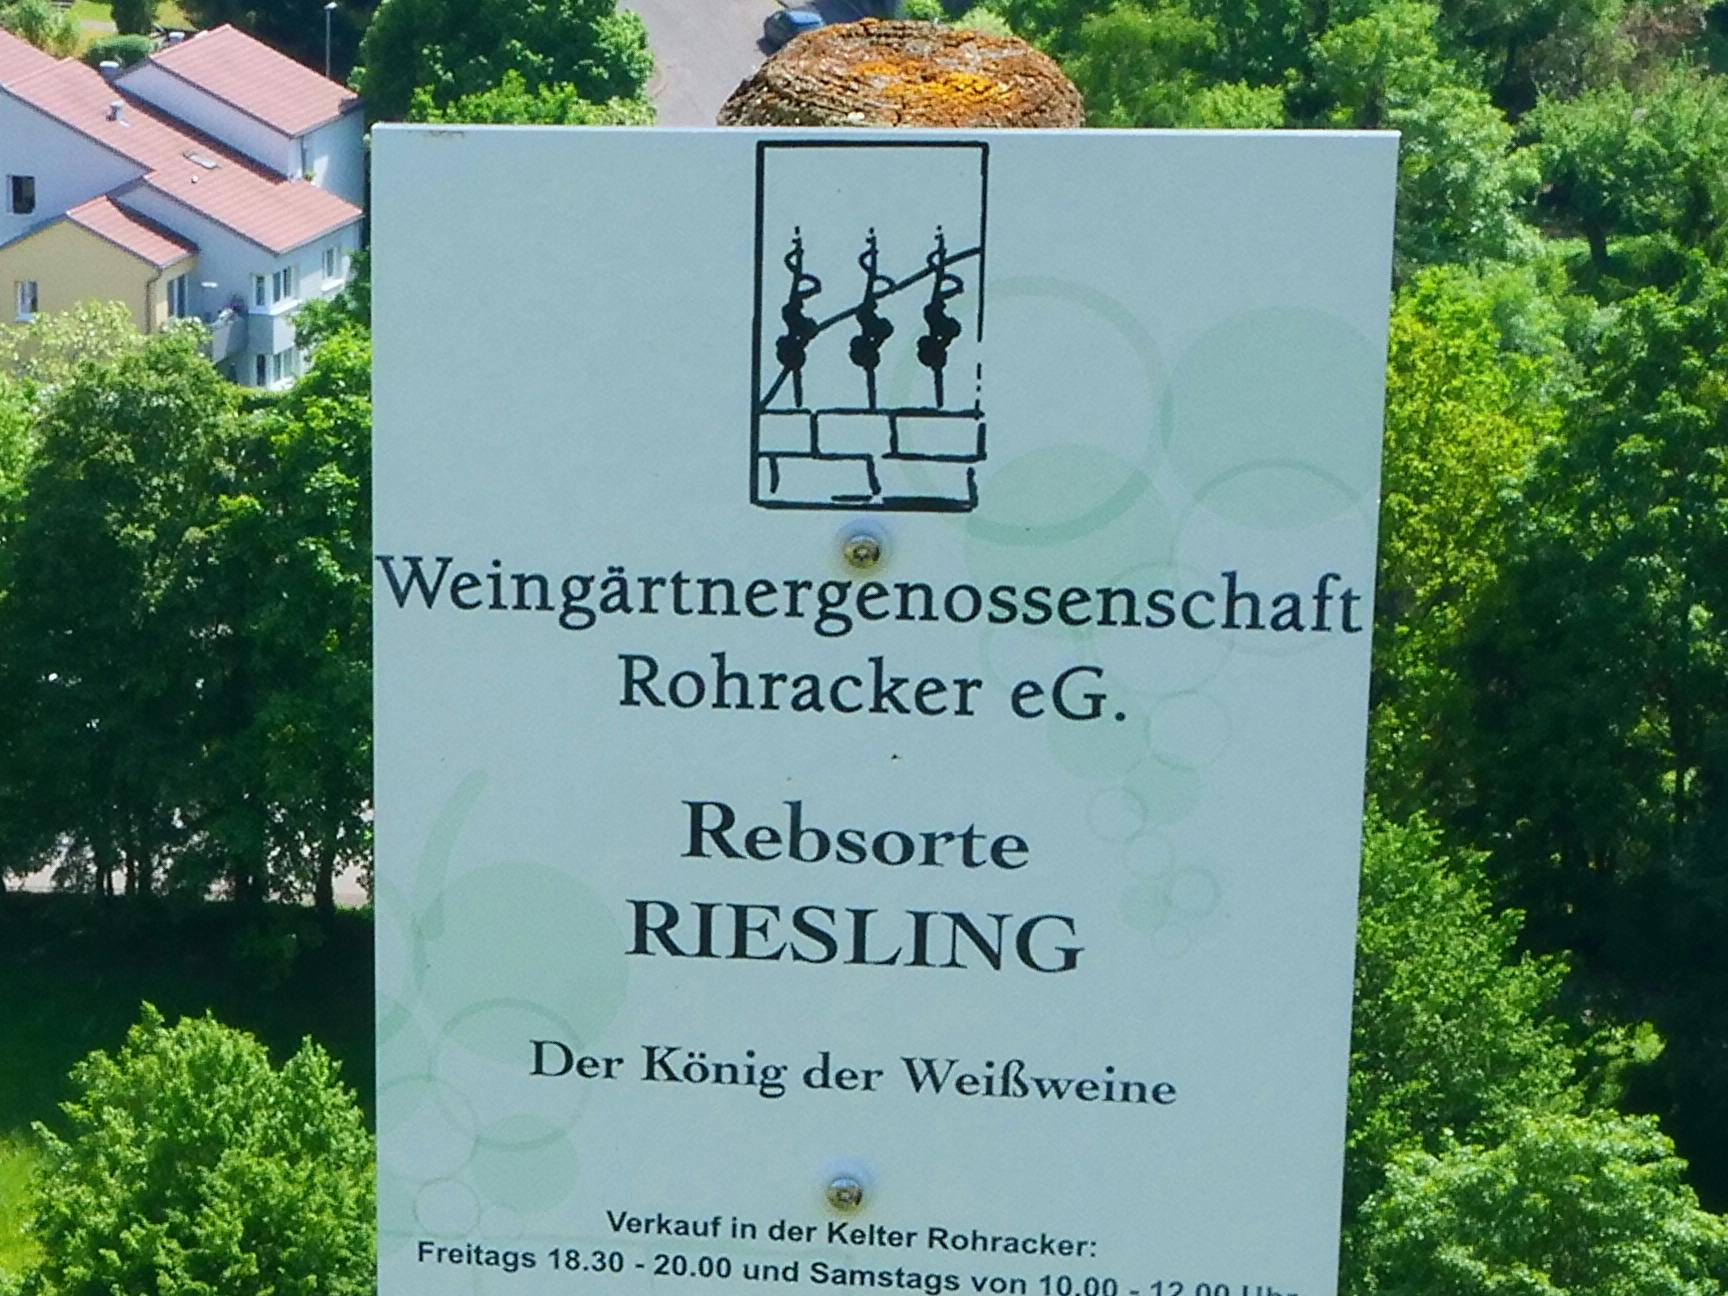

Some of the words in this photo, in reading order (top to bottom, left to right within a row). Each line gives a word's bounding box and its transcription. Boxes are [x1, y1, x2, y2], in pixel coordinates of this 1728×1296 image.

[376, 553, 1364, 638] Weingärtnergenossenschaft
[617, 653, 984, 718] Rohracker
[1010, 665, 1127, 722] eG.
[680, 799, 1030, 870] Rebsorte
[624, 898, 1086, 974] RIESLING
[529, 1039, 625, 1080] Der
[640, 1044, 789, 1099] König
[802, 1050, 884, 1092] der
[900, 1056, 1177, 1106] Weißweine
[417, 1240, 537, 1273] Freitags
[548, 1247, 625, 1273] 18.30
[653, 1253, 732, 1279] 20.00
[743, 1260, 800, 1283] und
[809, 1261, 962, 1294] Samstags
[970, 1275, 1027, 1296] von
[606, 1209, 723, 1238] Verkauf
[730, 1216, 758, 1241] in
[767, 1218, 818, 1243] der
[827, 1221, 919, 1248] Kelter
[927, 1226, 1097, 1258] Rohracker:
